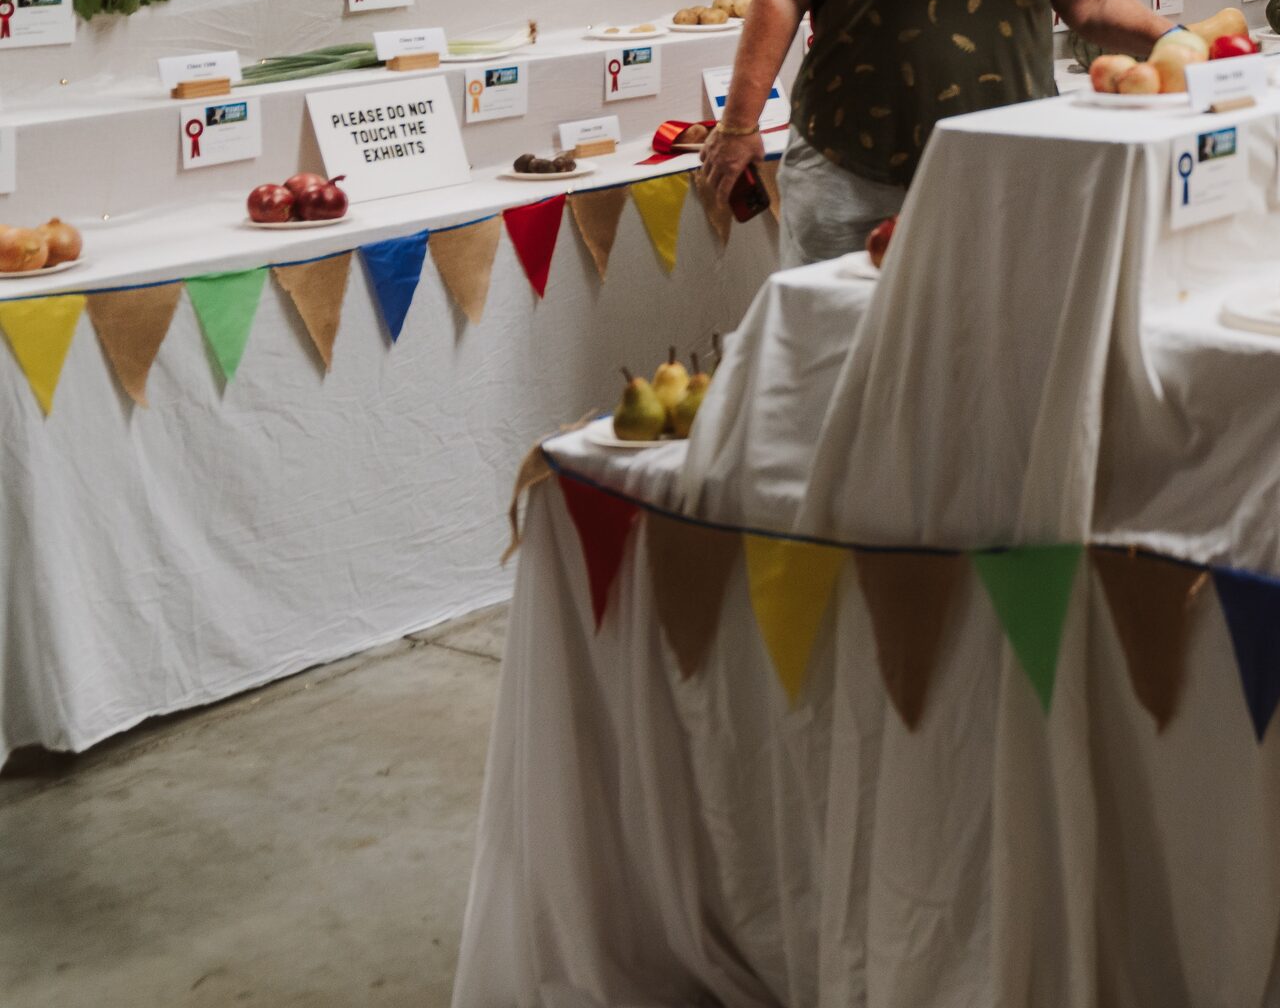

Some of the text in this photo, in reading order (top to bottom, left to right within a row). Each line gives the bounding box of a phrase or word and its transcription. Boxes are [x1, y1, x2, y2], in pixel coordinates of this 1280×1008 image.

[331, 99, 435, 129] PLEASE DO NOT
[350, 120, 427, 145] TOUCH THE
[363, 140, 426, 163] EXHIBITS
